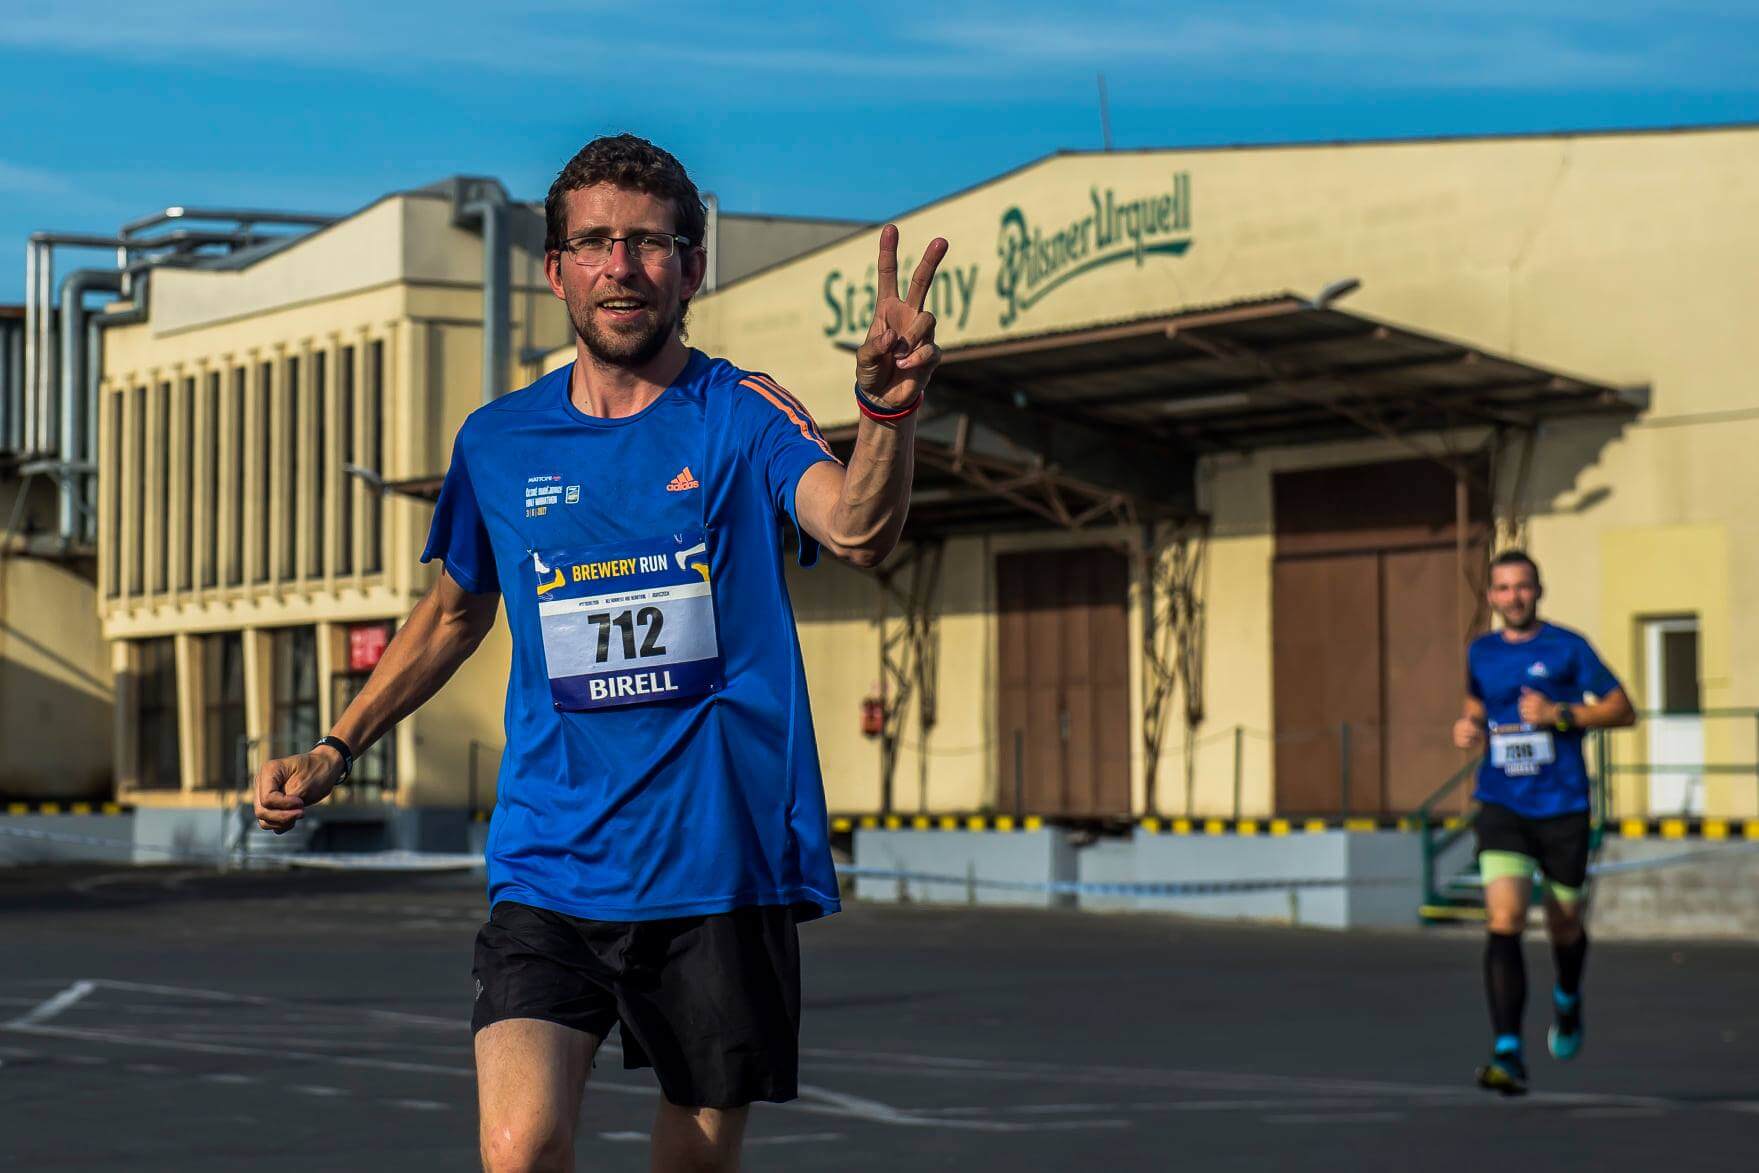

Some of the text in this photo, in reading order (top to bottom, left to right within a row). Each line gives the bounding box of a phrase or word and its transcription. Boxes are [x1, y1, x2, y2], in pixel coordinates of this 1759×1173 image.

[823, 169, 1192, 337] Stáíny Pilsner Urquell
[666, 480, 700, 492] adidas
[572, 553, 669, 583] BREWERY RUN
[587, 606, 667, 664] 712
[588, 670, 679, 701] BIRELL
